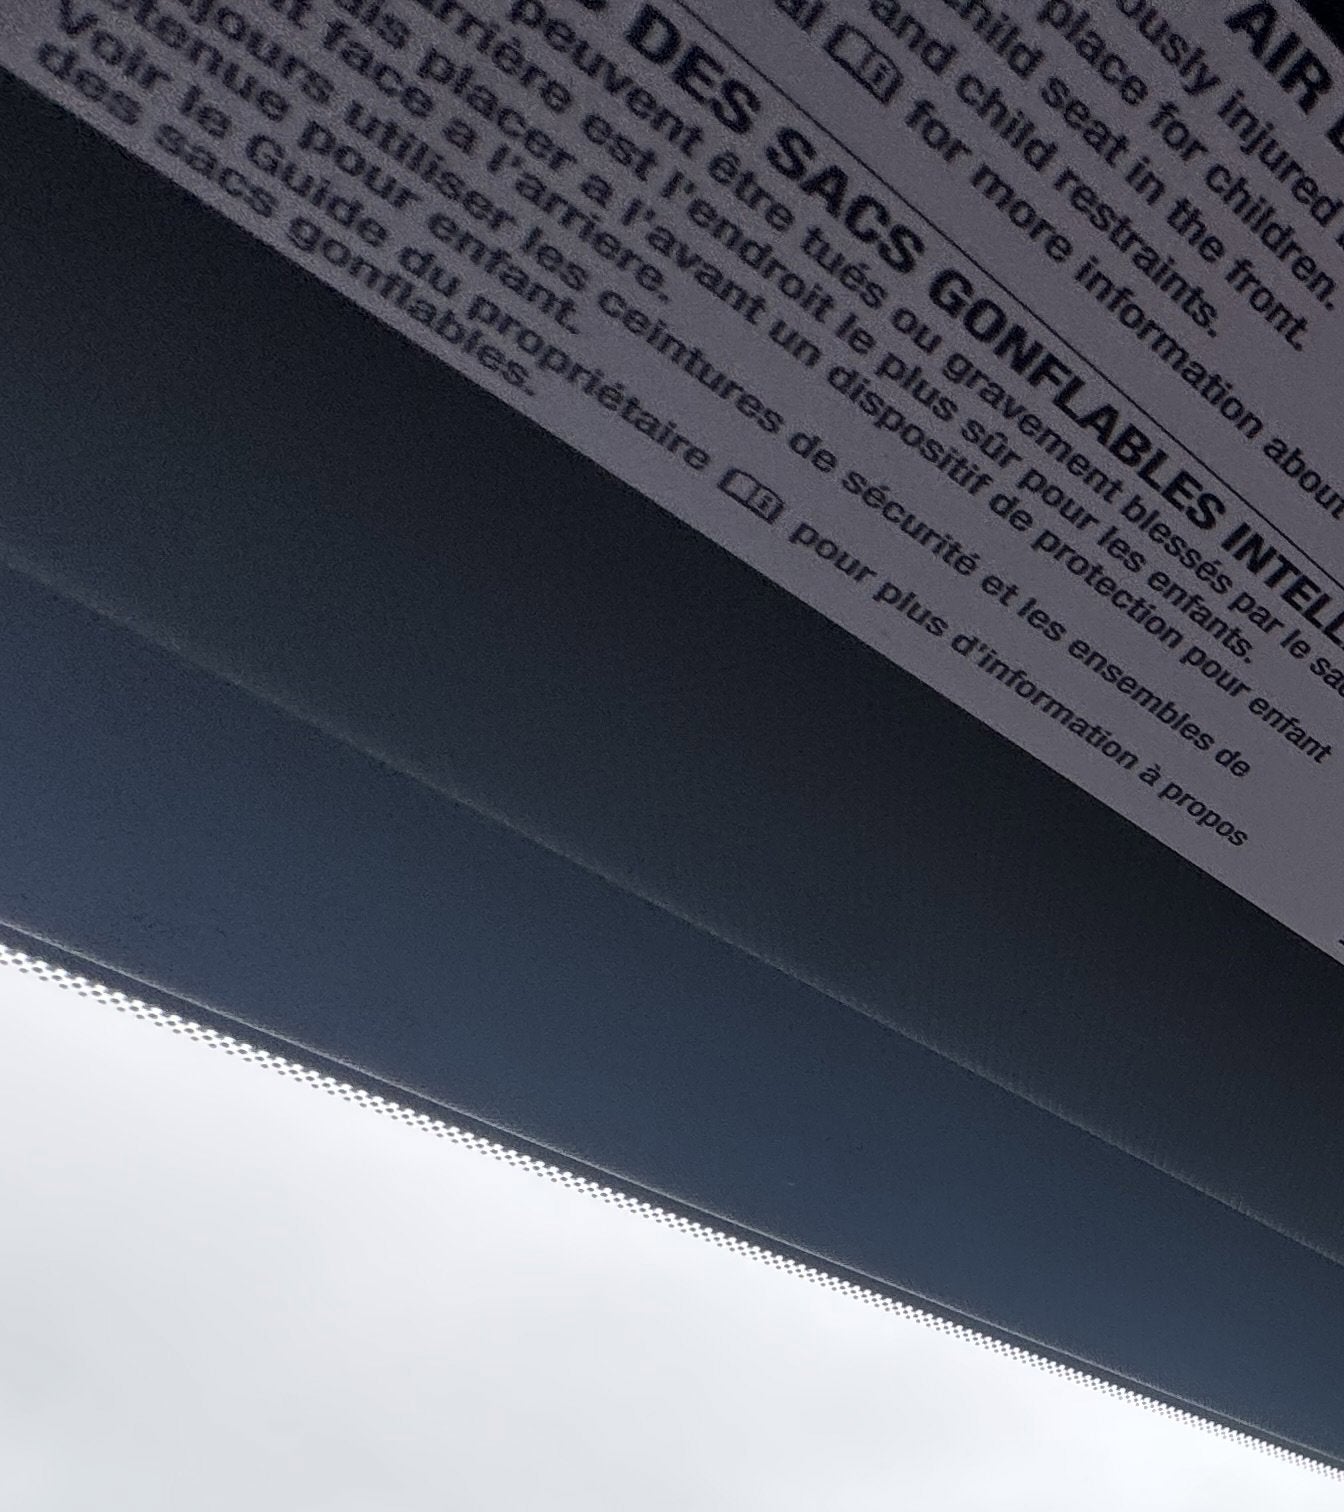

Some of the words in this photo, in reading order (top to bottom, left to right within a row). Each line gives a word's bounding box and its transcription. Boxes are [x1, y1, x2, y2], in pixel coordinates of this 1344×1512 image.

[37, 43, 141, 126] des
[155, 124, 277, 218] sacs
[288, 216, 534, 396] gonflables.
[113, 0, 290, 122] tenue
[297, 120, 420, 209] pour
[428, 213, 578, 335] enfant.
[323, 20, 435, 119] face
[946, 0, 1045, 80] hild
[1040, 76, 1129, 167] seat
[1125, 155, 1166, 206] in
[1166, 197, 1225, 264] the
[1225, 258, 1308, 351] front.
[955, 73, 1059, 172] child
[1053, 167, 1218, 338] restraints.
[1148, 101, 1209, 162] for
[1204, 163, 1336, 311] children.
[1217, 89, 1344, 228] injured
[1224, 0, 1334, 115] AIR
[344, 101, 516, 231] utiliser
[520, 227, 589, 292] les
[597, 290, 784, 434] ceintures
[788, 432, 837, 473] de
[841, 471, 981, 576] sécurité
[980, 575, 1019, 607] et
[1017, 597, 1067, 642] les
[1067, 639, 1215, 751] ensembles
[1214, 748, 1251, 778] de
[416, 47, 577, 171] placer
[621, 198, 766, 325] l'avant
[768, 319, 822, 368] un
[826, 366, 993, 495] dispositif
[988, 493, 1034, 532] de
[1030, 529, 1184, 649] protection
[1179, 645, 1252, 697] pour
[1248, 697, 1332, 764] enfant
[421, 0, 573, 114] rrière
[581, 113, 658, 182] est
[661, 171, 835, 323] l'endroit
[835, 312, 876, 355] le
[874, 352, 959, 422] plus
[960, 419, 1023, 468] sûr
[1016, 467, 1100, 530] pour
[1097, 525, 1147, 573] les
[1147, 570, 1253, 664] enfants.
[624, 3, 762, 136] DES
[765, 127, 925, 275] SACS
[928, 268, 1227, 531] GONFLABLES
[708, 151, 795, 232] être
[800, 226, 888, 310] tués
[891, 307, 943, 355] ou
[941, 352, 1124, 504] gravement
[1120, 494, 1233, 595] blessés
[1227, 591, 1285, 634] par
[1280, 628, 1312, 659] le
[906, 99, 972, 163] for
[970, 164, 1073, 263] more
[1074, 255, 1264, 440] information
[180, 85, 231, 139] le
[245, 134, 388, 248] Guide
[399, 247, 461, 298] du
[467, 295, 711, 471] propriétaire
[788, 522, 877, 582] pour
[872, 581, 948, 637] plus
[950, 634, 1139, 770] d'information
[1138, 764, 1162, 787] à
[1157, 782, 1248, 846] propos
